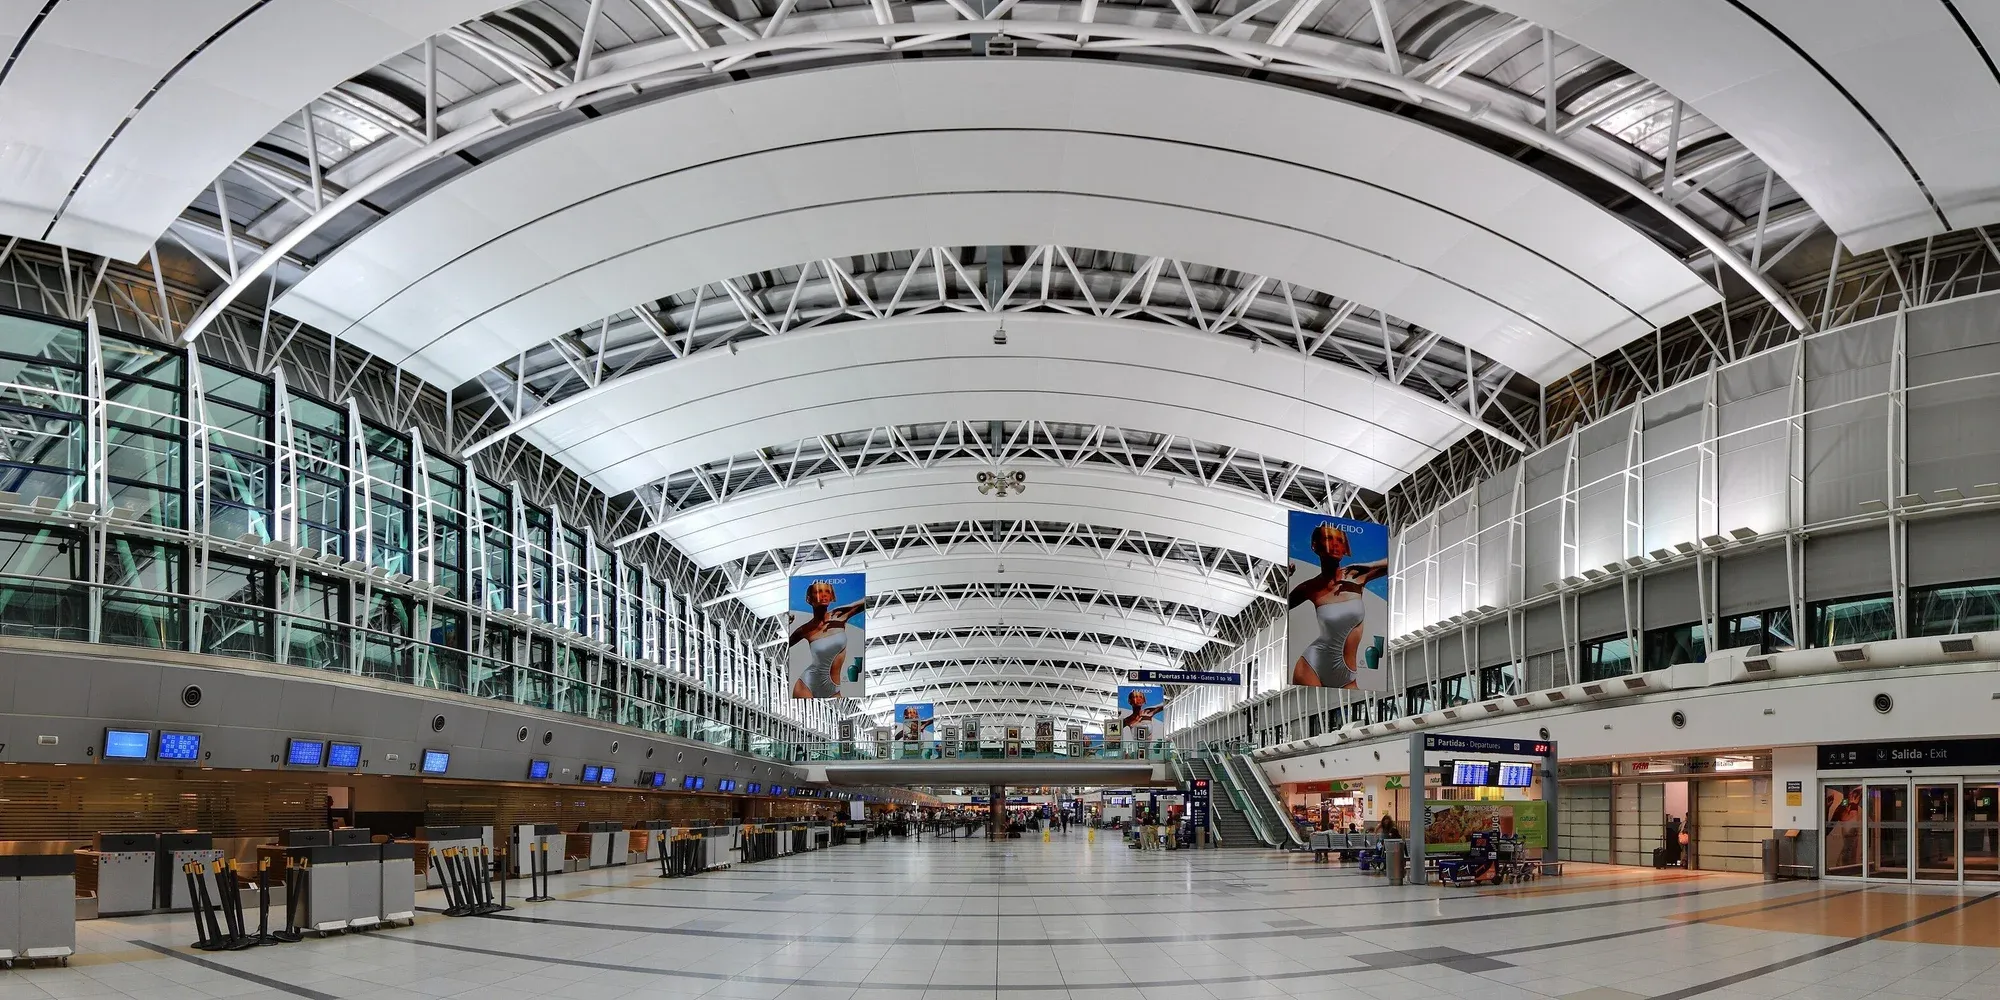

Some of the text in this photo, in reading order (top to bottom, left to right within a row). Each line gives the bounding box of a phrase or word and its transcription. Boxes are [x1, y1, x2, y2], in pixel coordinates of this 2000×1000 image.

[1315, 520, 1364, 534] SHISEIDO
[1438, 739, 1501, 749] Partidas Departures
[86, 747, 94, 756] 8
[205, 751, 211, 760] 9
[1891, 748, 1947, 759] Salida Exit
[270, 755, 279, 763] 10
[362, 760, 369, 768] 11
[409, 763, 417, 771] 12
[1632, 762, 1649, 770] TAM
[1424, 805, 1432, 826] WOK
